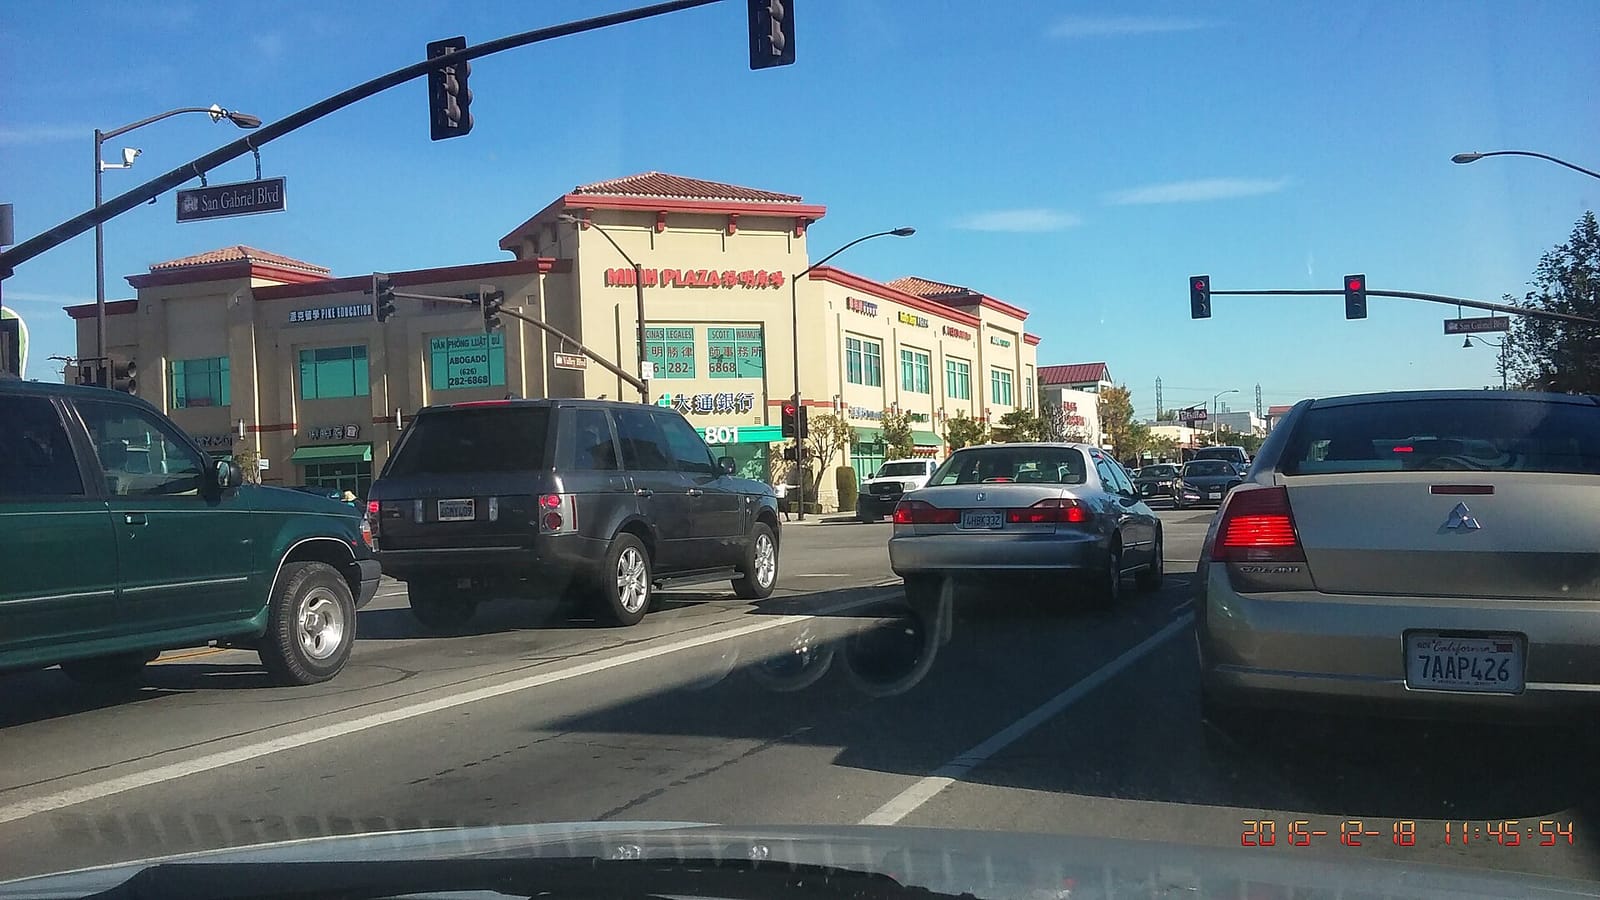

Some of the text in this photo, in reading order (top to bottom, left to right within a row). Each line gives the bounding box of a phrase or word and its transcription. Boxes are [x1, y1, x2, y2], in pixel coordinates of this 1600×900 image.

[201, 185, 279, 212] San Gabriel Blvd
[661, 269, 720, 288] PLAZA
[337, 304, 372, 318] EDUCATION
[667, 329, 692, 339] LEGALES
[711, 330, 730, 339] SCOTT
[449, 354, 487, 365] ABOGADO
[459, 367, 477, 376] (626)
[449, 375, 489, 386] 282-6868
[674, 392, 755, 411] 大通銀行
[704, 427, 739, 444] 801
[1432, 640, 1491, 656] California
[1419, 656, 1510, 682] 7AAP426
